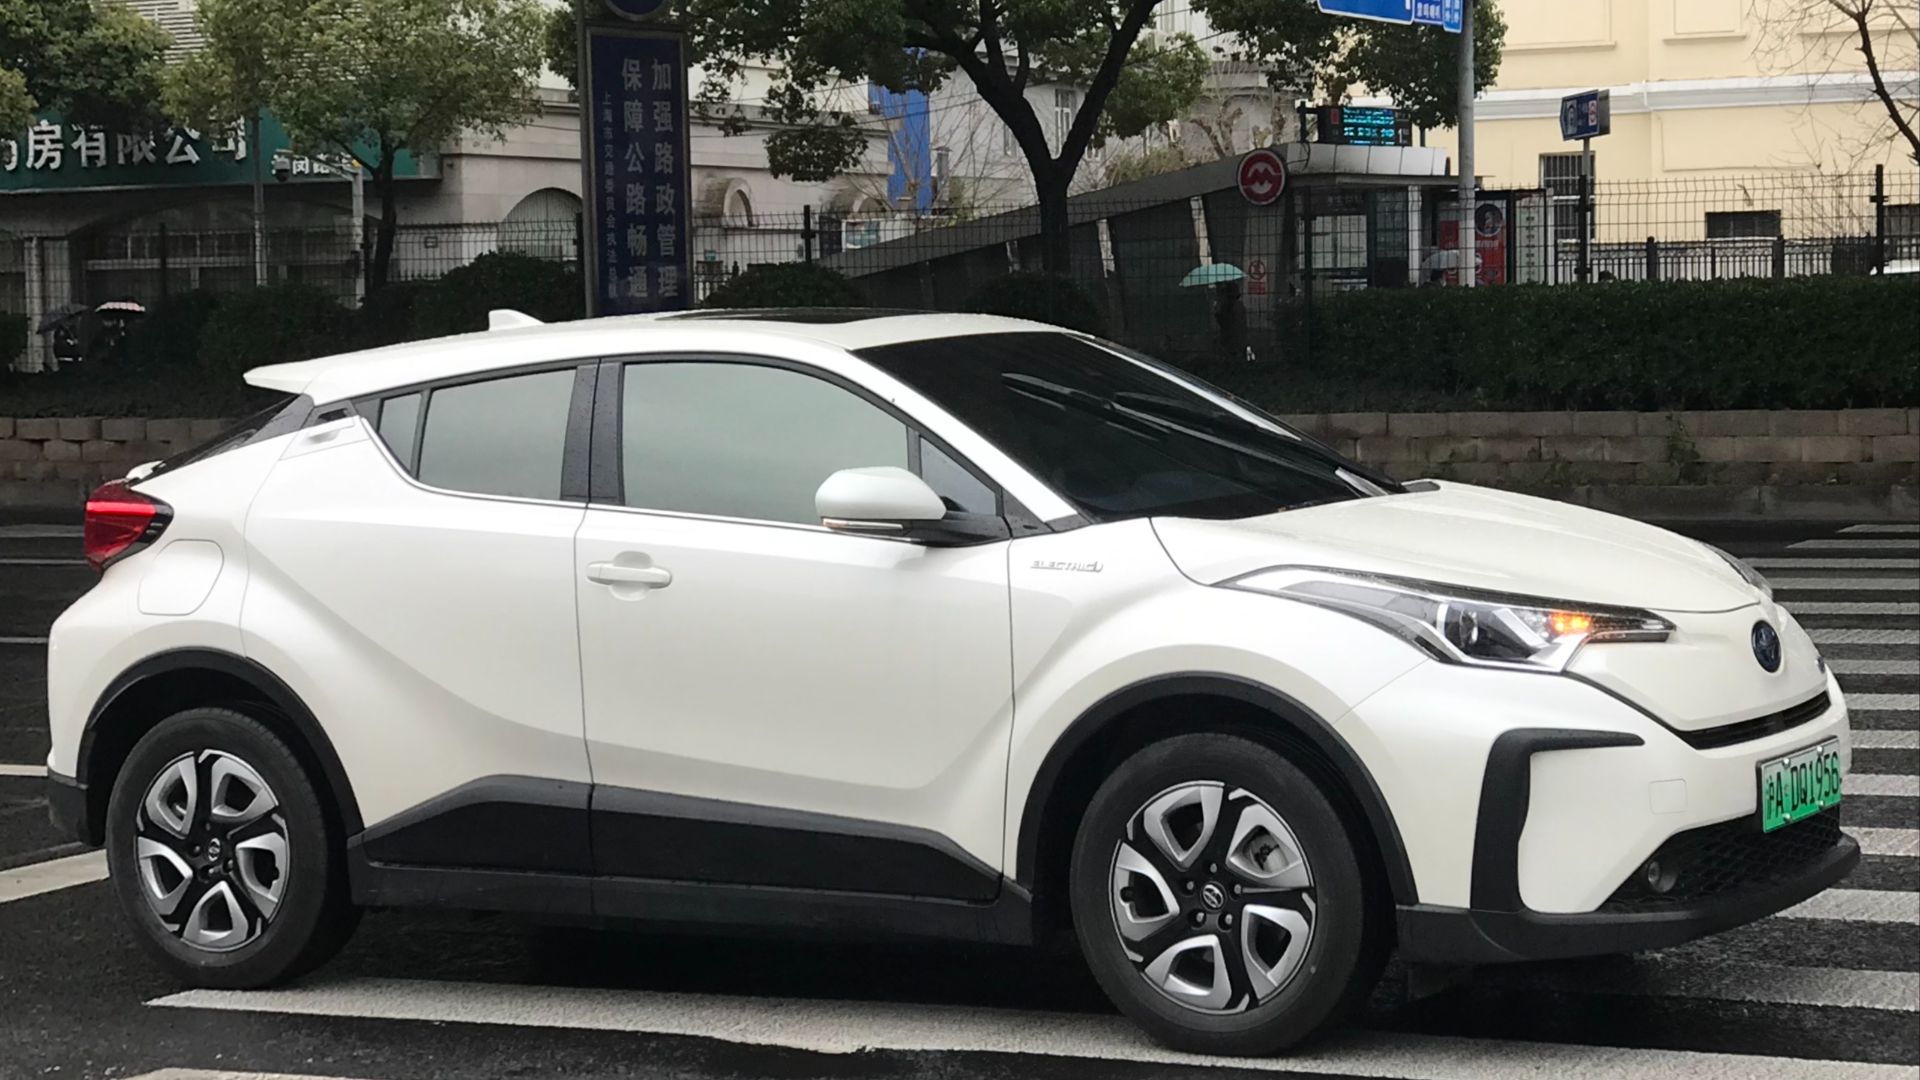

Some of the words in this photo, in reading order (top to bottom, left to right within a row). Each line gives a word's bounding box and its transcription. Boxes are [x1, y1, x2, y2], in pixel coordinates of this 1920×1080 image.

[621, 58, 648, 298] 保障公路畅通
[652, 58, 678, 297] 加强路政管理
